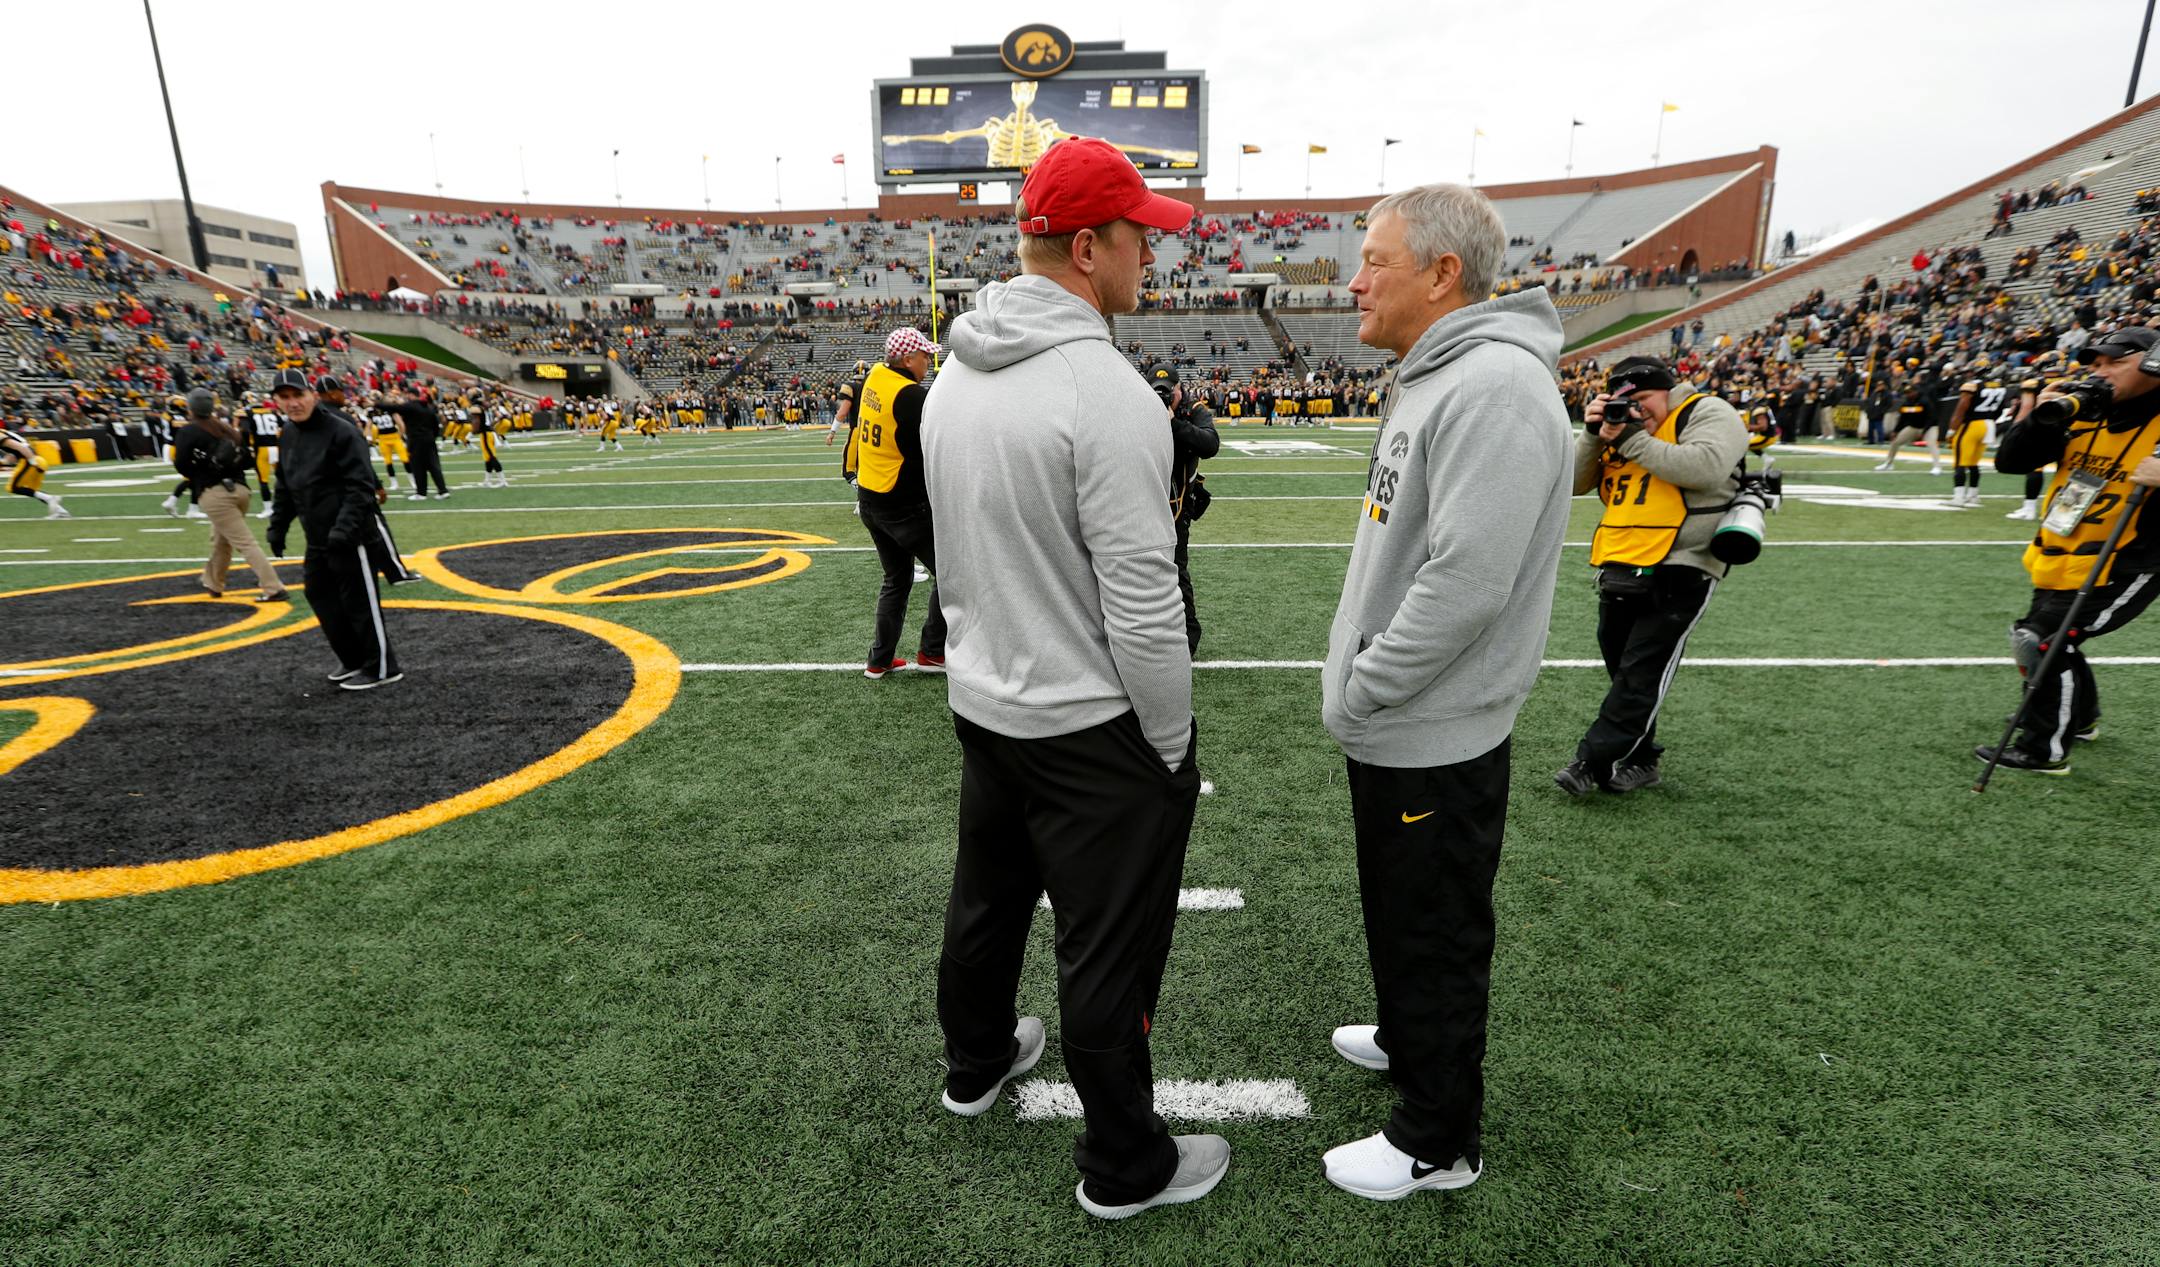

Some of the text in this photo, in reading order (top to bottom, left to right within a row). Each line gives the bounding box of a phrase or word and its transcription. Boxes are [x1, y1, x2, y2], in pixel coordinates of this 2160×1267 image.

[961, 184, 977, 199] 25
[1974, 387, 2007, 412] 23
[252, 413, 279, 436] 16
[858, 416, 883, 448] 59
